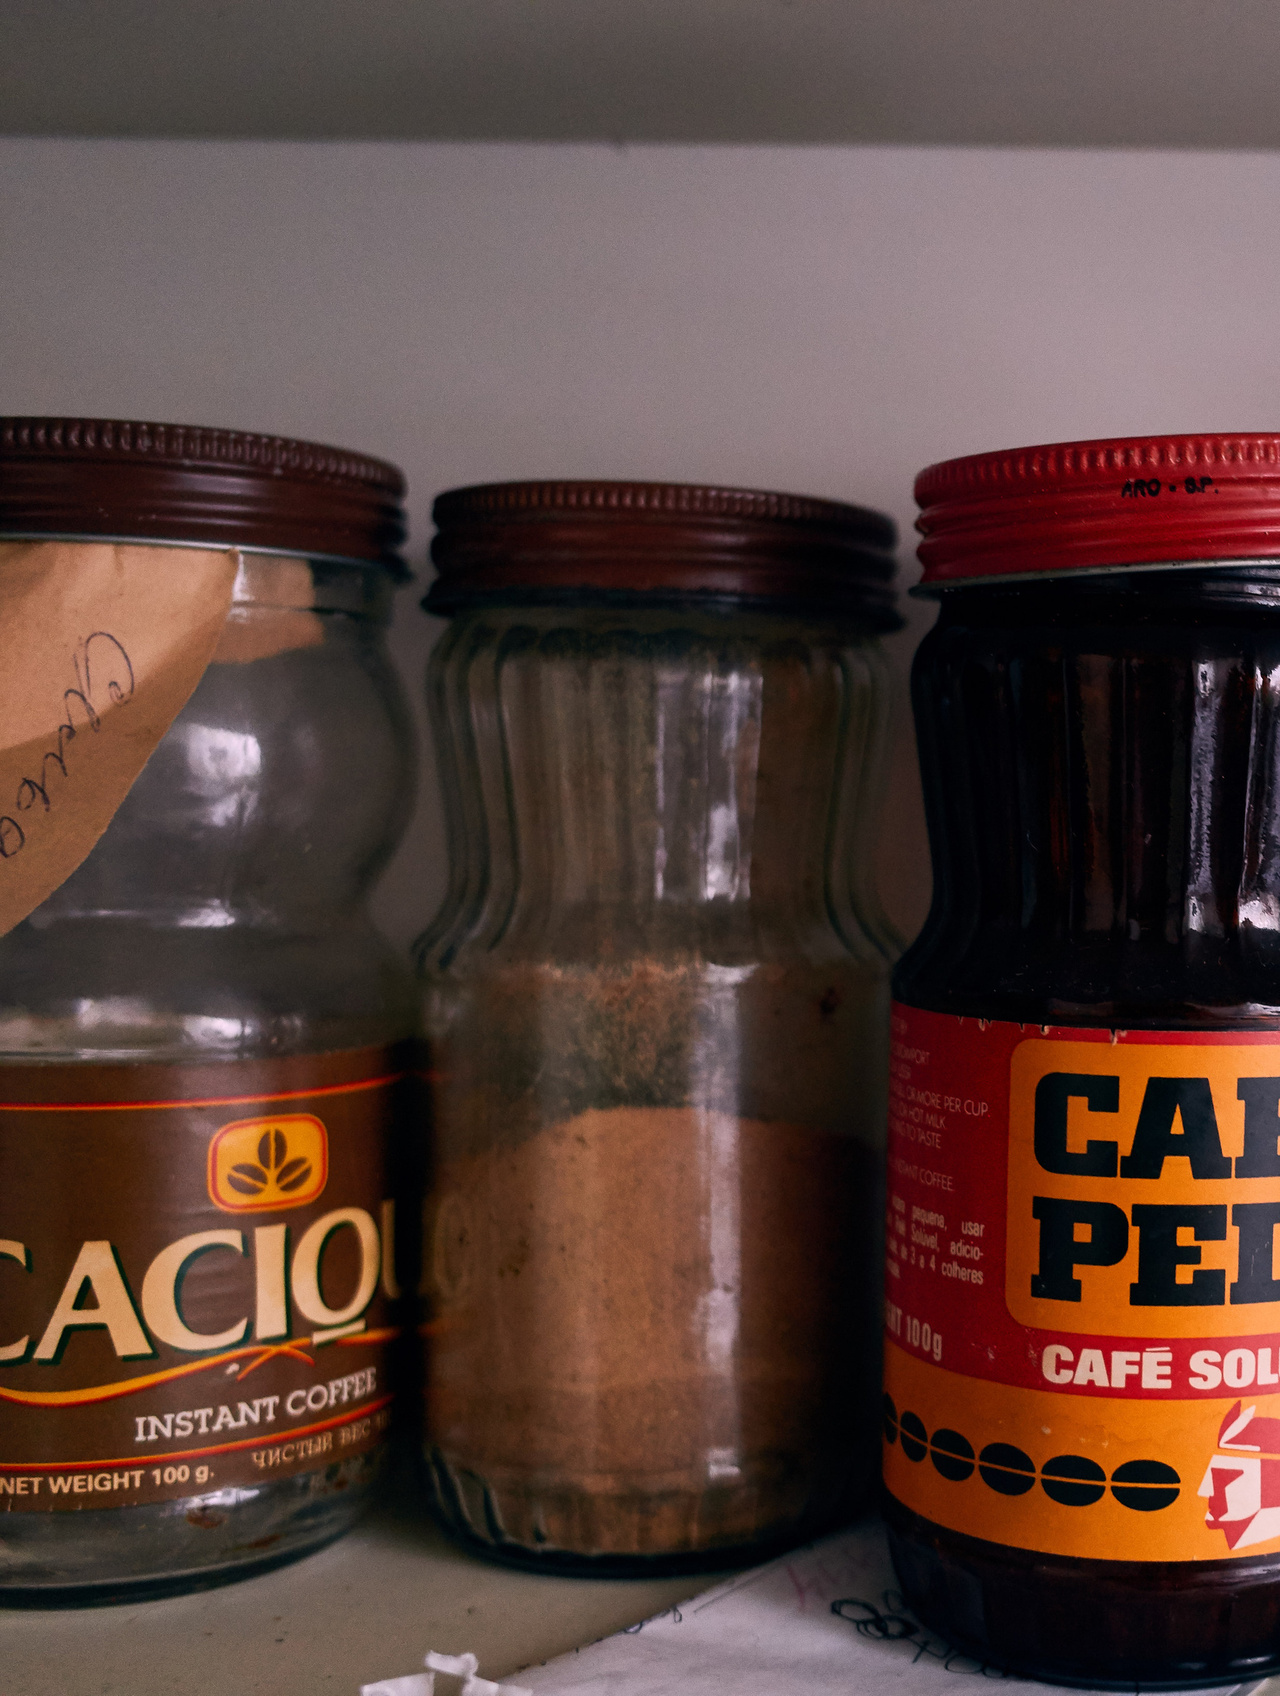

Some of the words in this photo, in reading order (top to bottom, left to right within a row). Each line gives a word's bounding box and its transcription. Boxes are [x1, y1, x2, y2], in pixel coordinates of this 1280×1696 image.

[1121, 478, 1161, 498] ARO
[943, 1095, 962, 1113] PER
[962, 1099, 989, 1117] CUP
[961, 1220, 986, 1238] usar
[0, 1198, 402, 1366] ACIQ
[941, 1261, 984, 1286] colheres
[906, 1315, 943, 1362] 100g
[1041, 1344, 1173, 1389] CAFÉ
[134, 1396, 280, 1441] INSTANT
[286, 1366, 377, 1415] COFFEE
[0, 1477, 43, 1494] NET
[49, 1470, 145, 1494] WEIGHT
[151, 1465, 191, 1486] 100
